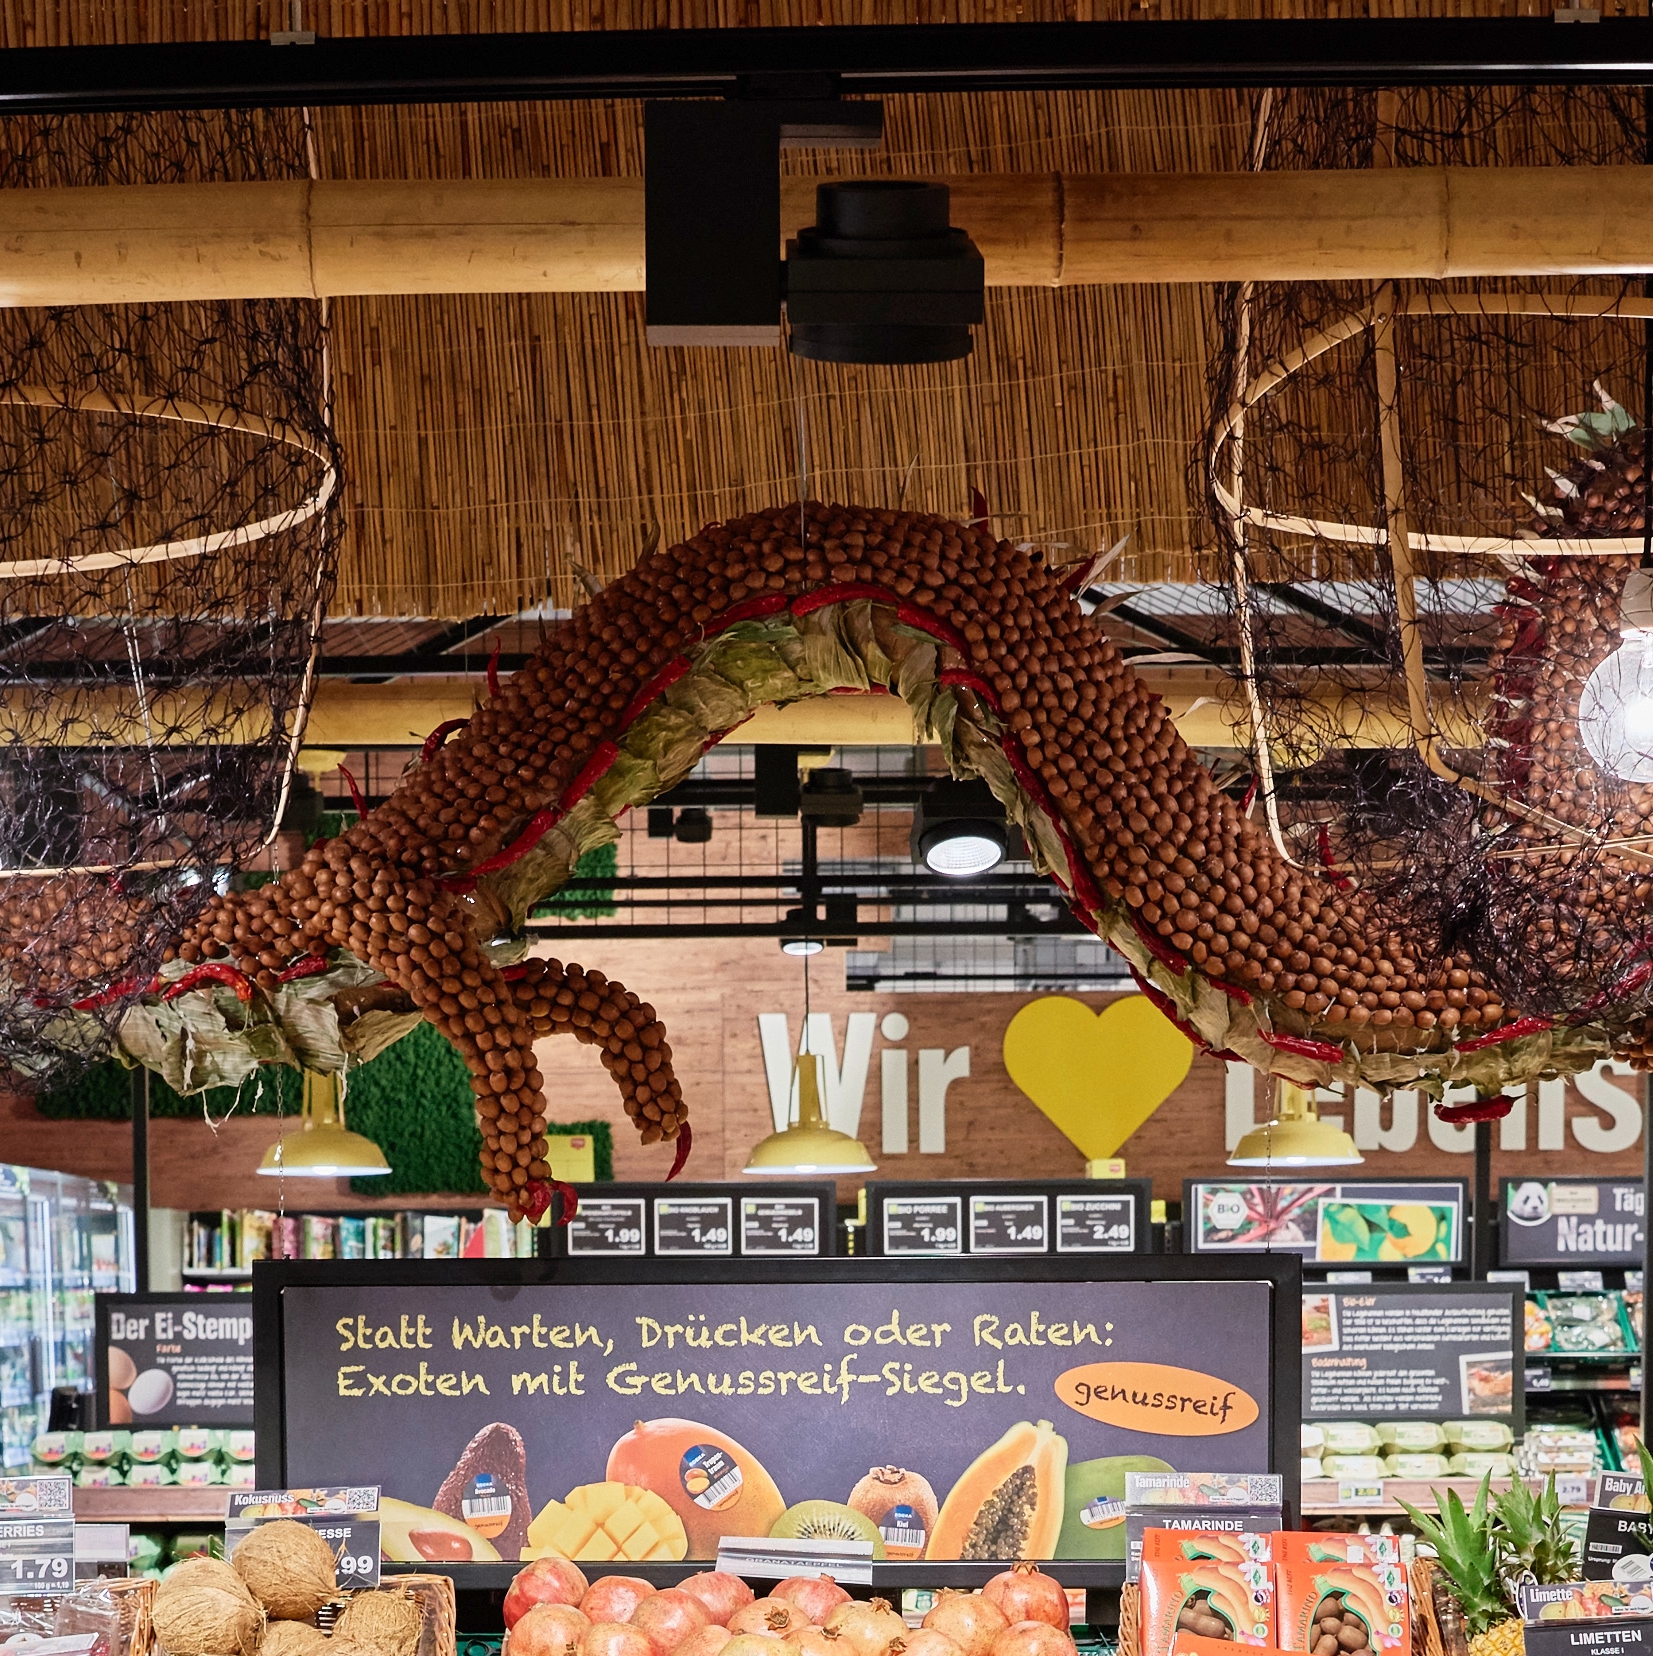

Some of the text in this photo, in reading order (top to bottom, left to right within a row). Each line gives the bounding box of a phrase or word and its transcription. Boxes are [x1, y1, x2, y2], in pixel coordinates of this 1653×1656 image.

[758, 1012, 970, 1154] Wir
[605, 1228, 640, 1242] 1.99
[692, 1228, 727, 1243] 1.49
[778, 1228, 814, 1242] 1.49
[920, 1228, 956, 1242] 1.99
[1008, 1226, 1042, 1240] 1.49
[1094, 1225, 1129, 1239] 2.49
[111, 1312, 148, 1340] Der
[336, 1308, 1115, 1356] Statt Warten, Drücken oder Raten:
[337, 1354, 1026, 1406] Exoten mit Genussreif-Siegel.
[1074, 1379, 1235, 1424] genussreif
[1133, 1475, 1190, 1489] Tamarinde
[1605, 1478, 1632, 1495] Baby
[234, 1492, 295, 1506] Kokusnuss
[1163, 1519, 1243, 1531] TAMARINDE
[11, 1558, 68, 1579] 1.79
[1530, 1589, 1573, 1602] Limette
[1571, 1630, 1642, 1646] LIMETTEN
